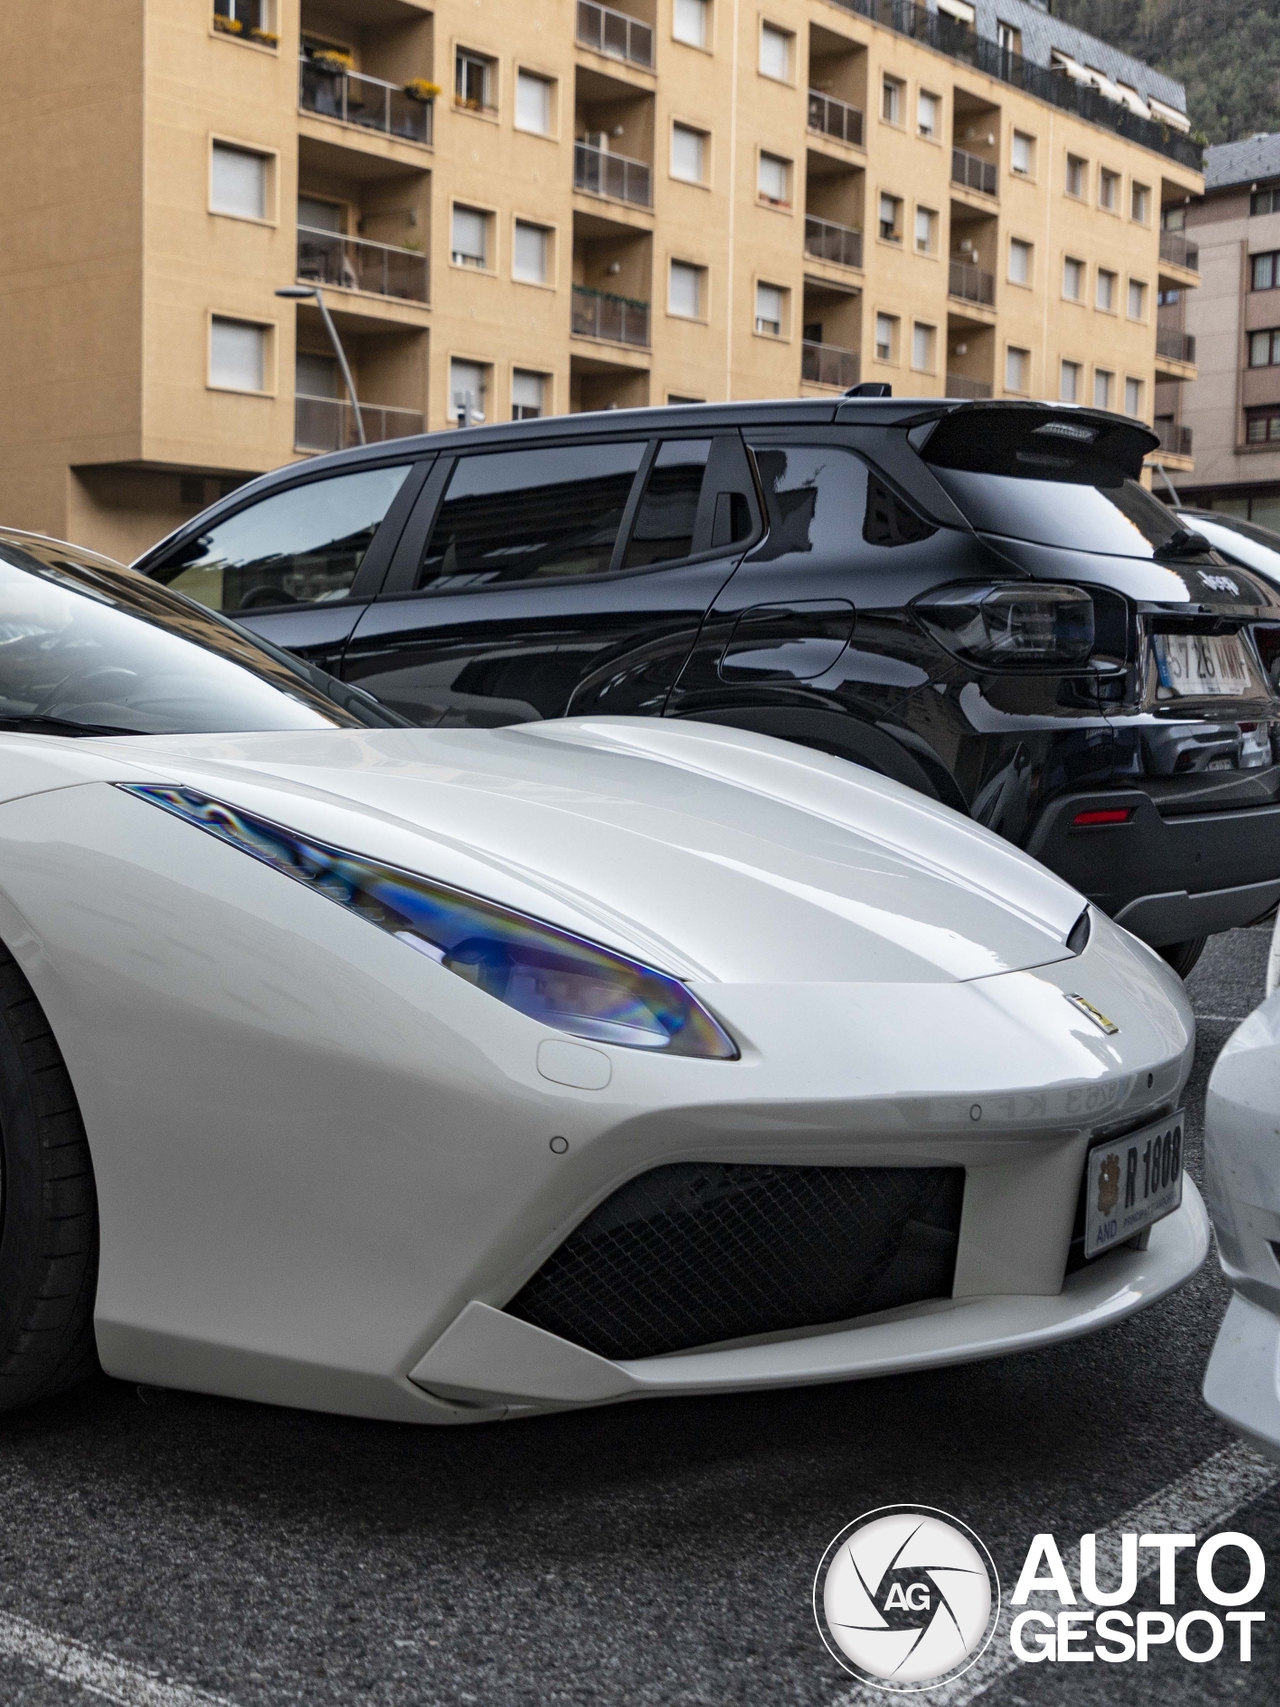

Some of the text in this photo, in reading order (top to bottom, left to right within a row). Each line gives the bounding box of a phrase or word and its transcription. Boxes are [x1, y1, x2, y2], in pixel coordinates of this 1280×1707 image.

[1196, 570, 1240, 597] Jeep
[1124, 1125, 1182, 1209] R 1808
[1097, 1219, 1118, 1245] AND
